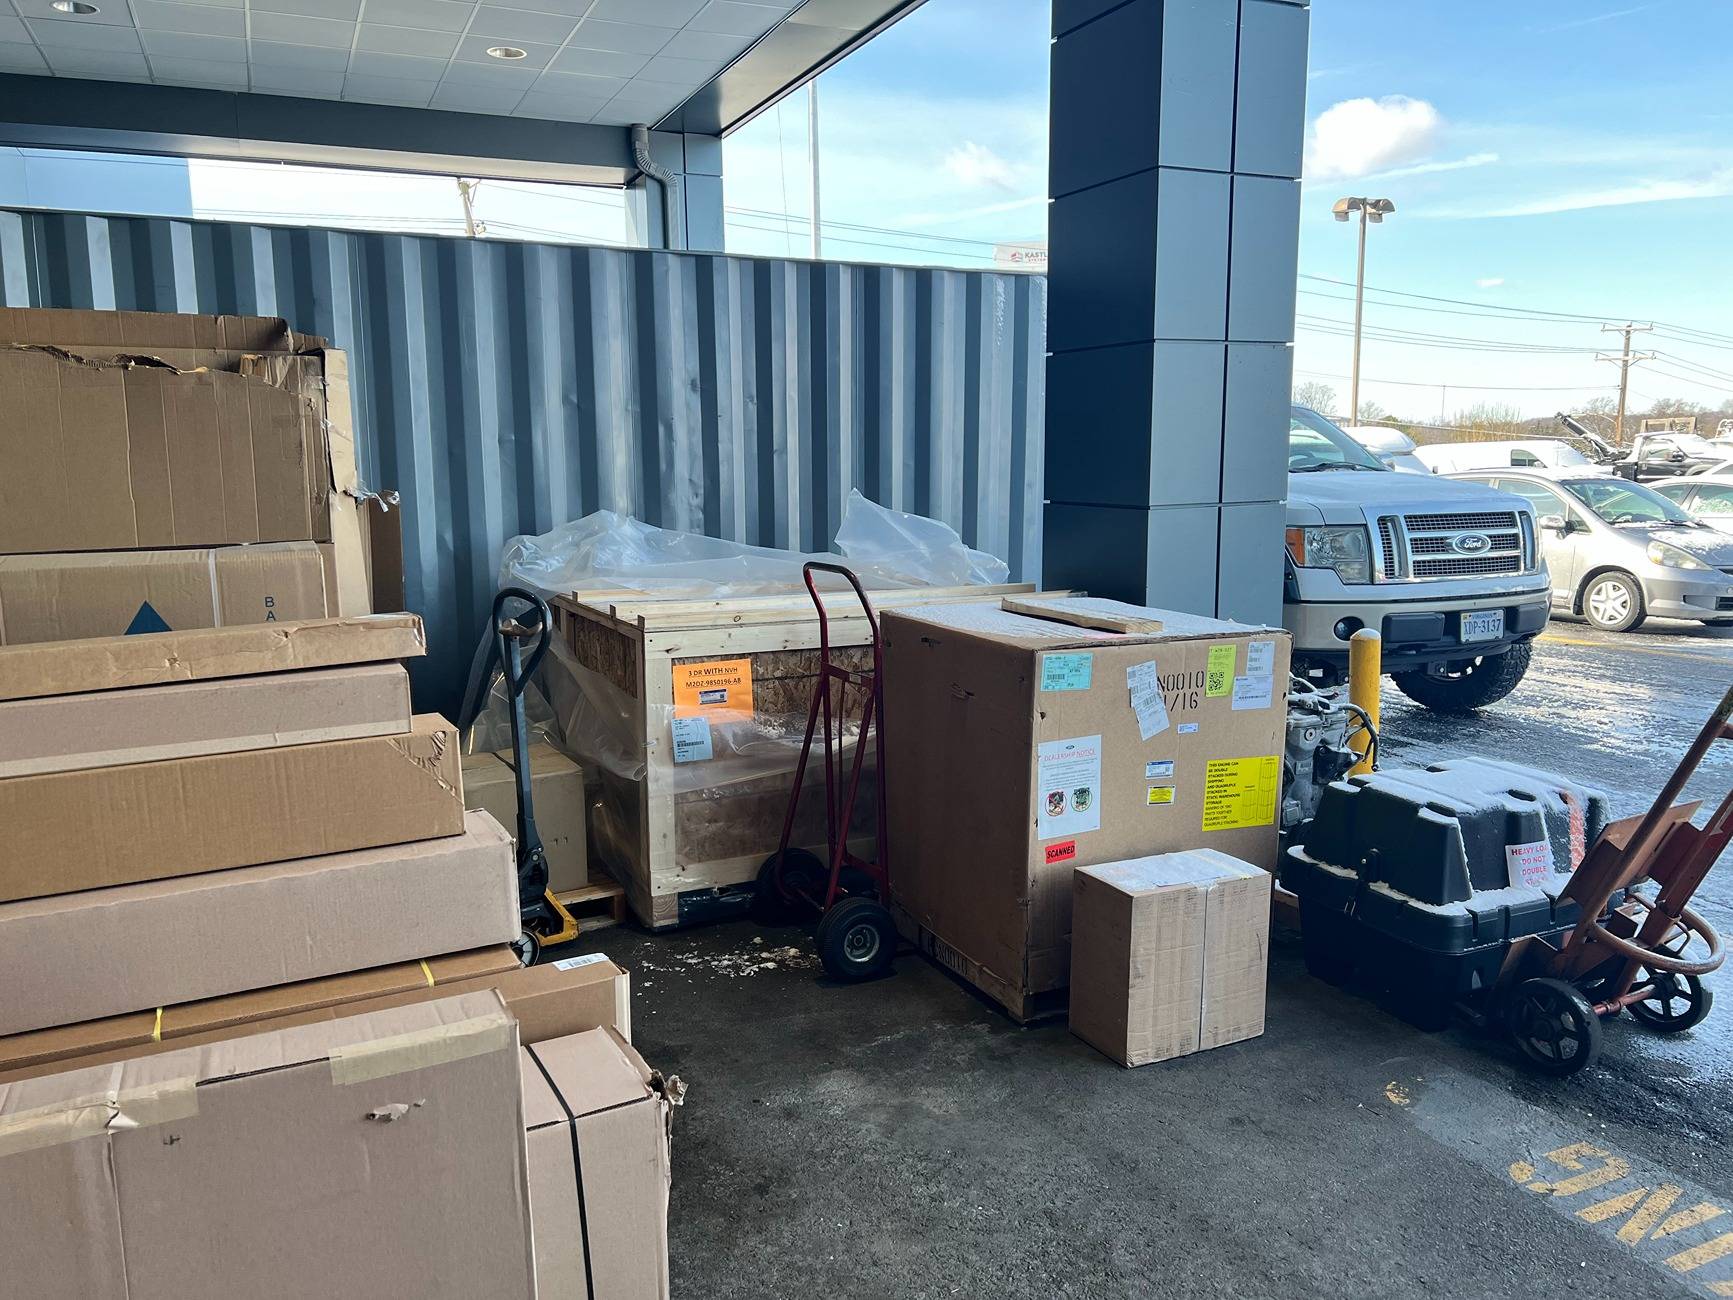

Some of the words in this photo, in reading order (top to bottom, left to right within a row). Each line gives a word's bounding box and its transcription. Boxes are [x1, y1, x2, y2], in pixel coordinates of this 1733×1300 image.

[1465, 538, 1482, 548] Ford
[1463, 619, 1501, 634] XDP-3137
[1044, 751, 1075, 761] DEALERSHIP
[1077, 748, 1096, 757] NOTICE
[1047, 846, 1075, 859] SCANNED
[1533, 855, 1545, 863] NOT
[1522, 865, 1547, 875] DOUBLE
